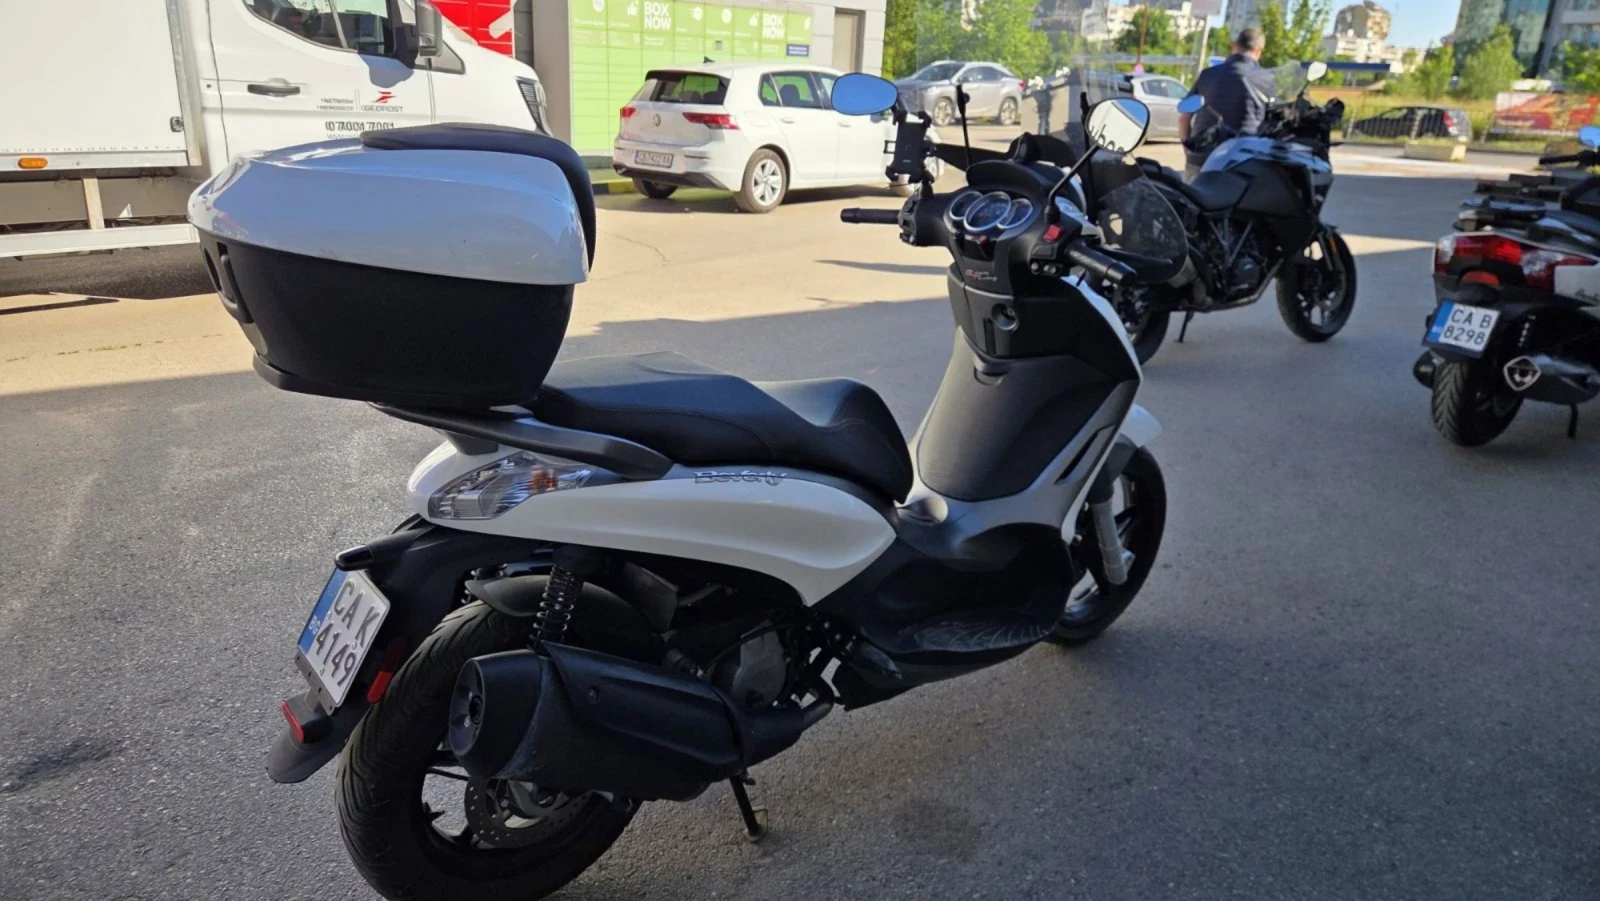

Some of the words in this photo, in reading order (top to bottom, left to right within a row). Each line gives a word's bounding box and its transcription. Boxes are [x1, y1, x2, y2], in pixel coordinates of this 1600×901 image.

[643, 1, 670, 17] BOX
[643, 16, 671, 30] NOW
[762, 13, 784, 28] BOX
[762, 27, 786, 40] NOW
[1451, 308, 1475, 325] CA
[1479, 313, 1493, 329] B
[1443, 325, 1486, 345] 8298
[308, 613, 321, 636] BG
[333, 580, 364, 631] CA
[354, 605, 381, 649] K
[315, 621, 357, 688] 4149
